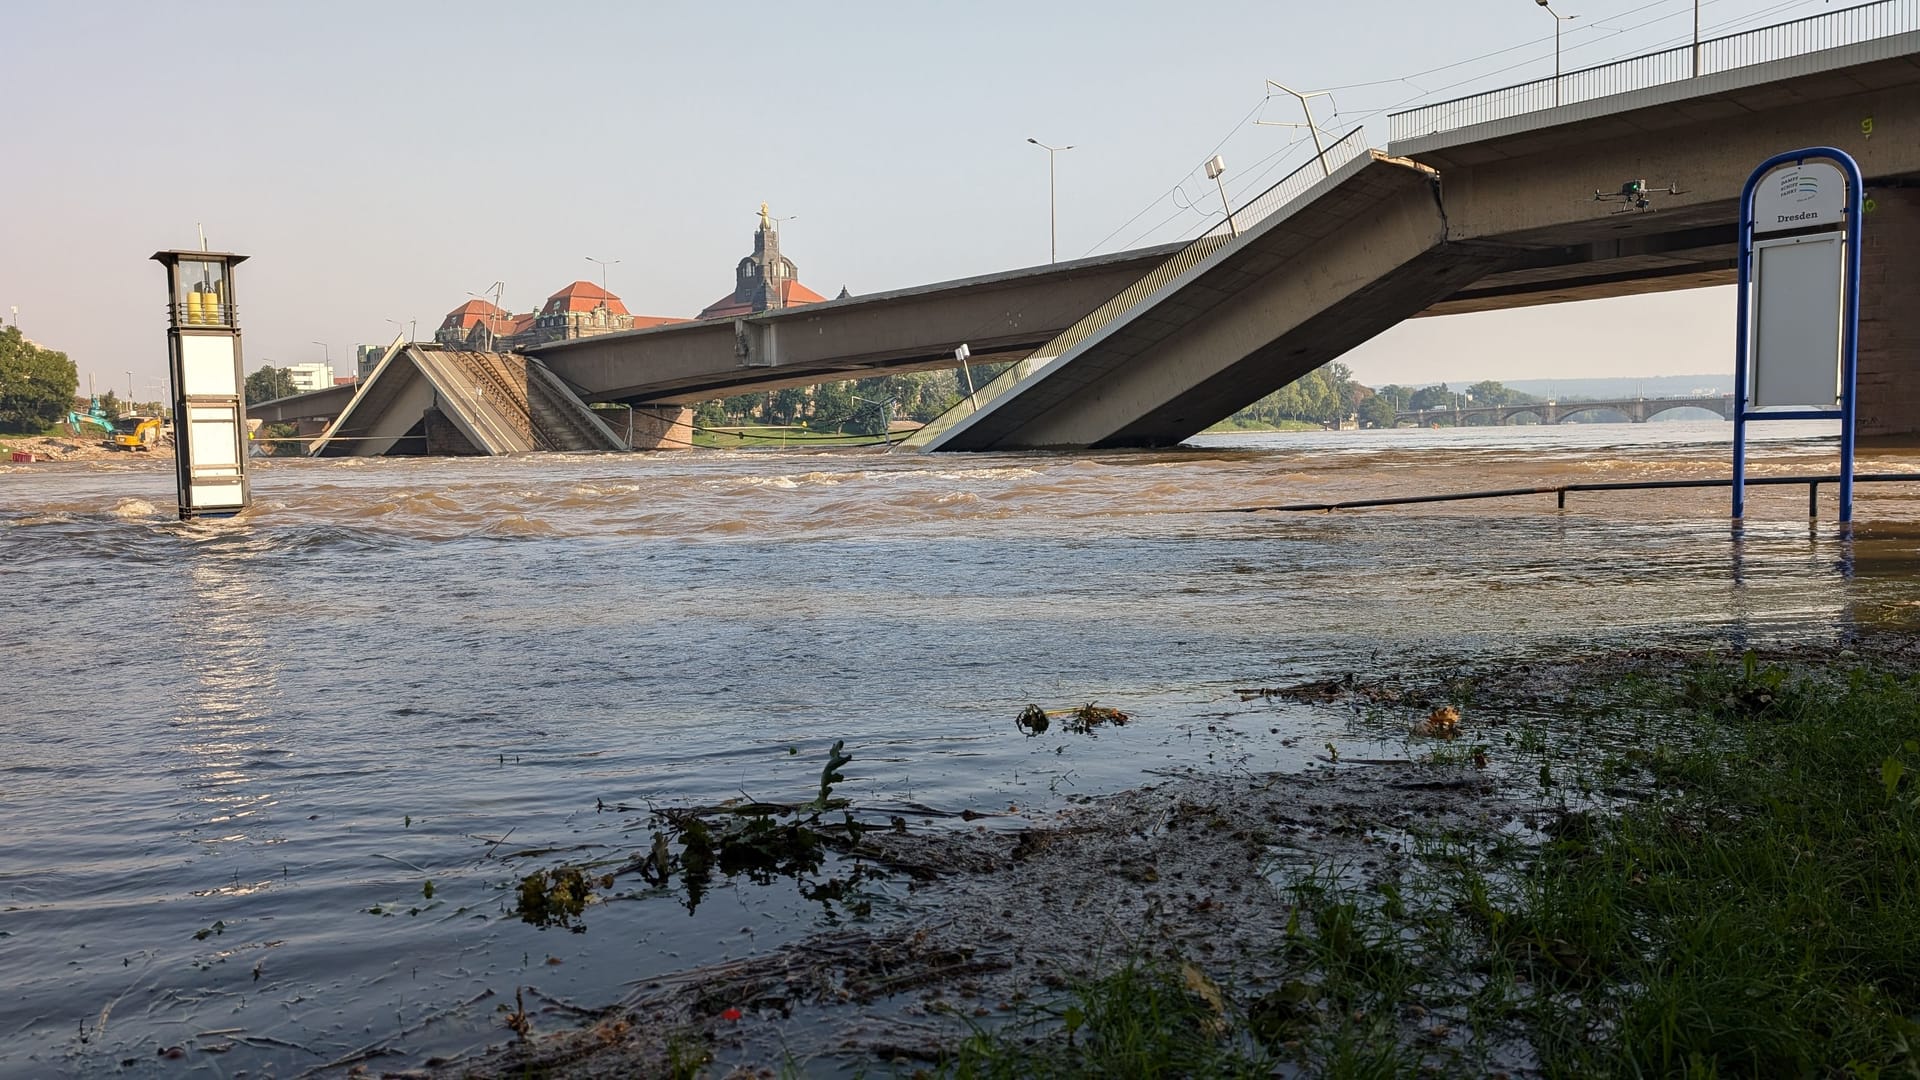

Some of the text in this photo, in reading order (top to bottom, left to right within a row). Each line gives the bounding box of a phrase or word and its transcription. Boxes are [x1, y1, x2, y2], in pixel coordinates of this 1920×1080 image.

[1781, 176, 1798, 186] DAMPF
[1781, 188, 1797, 198] FAHRT
[1777, 211, 1818, 223] Dresden
